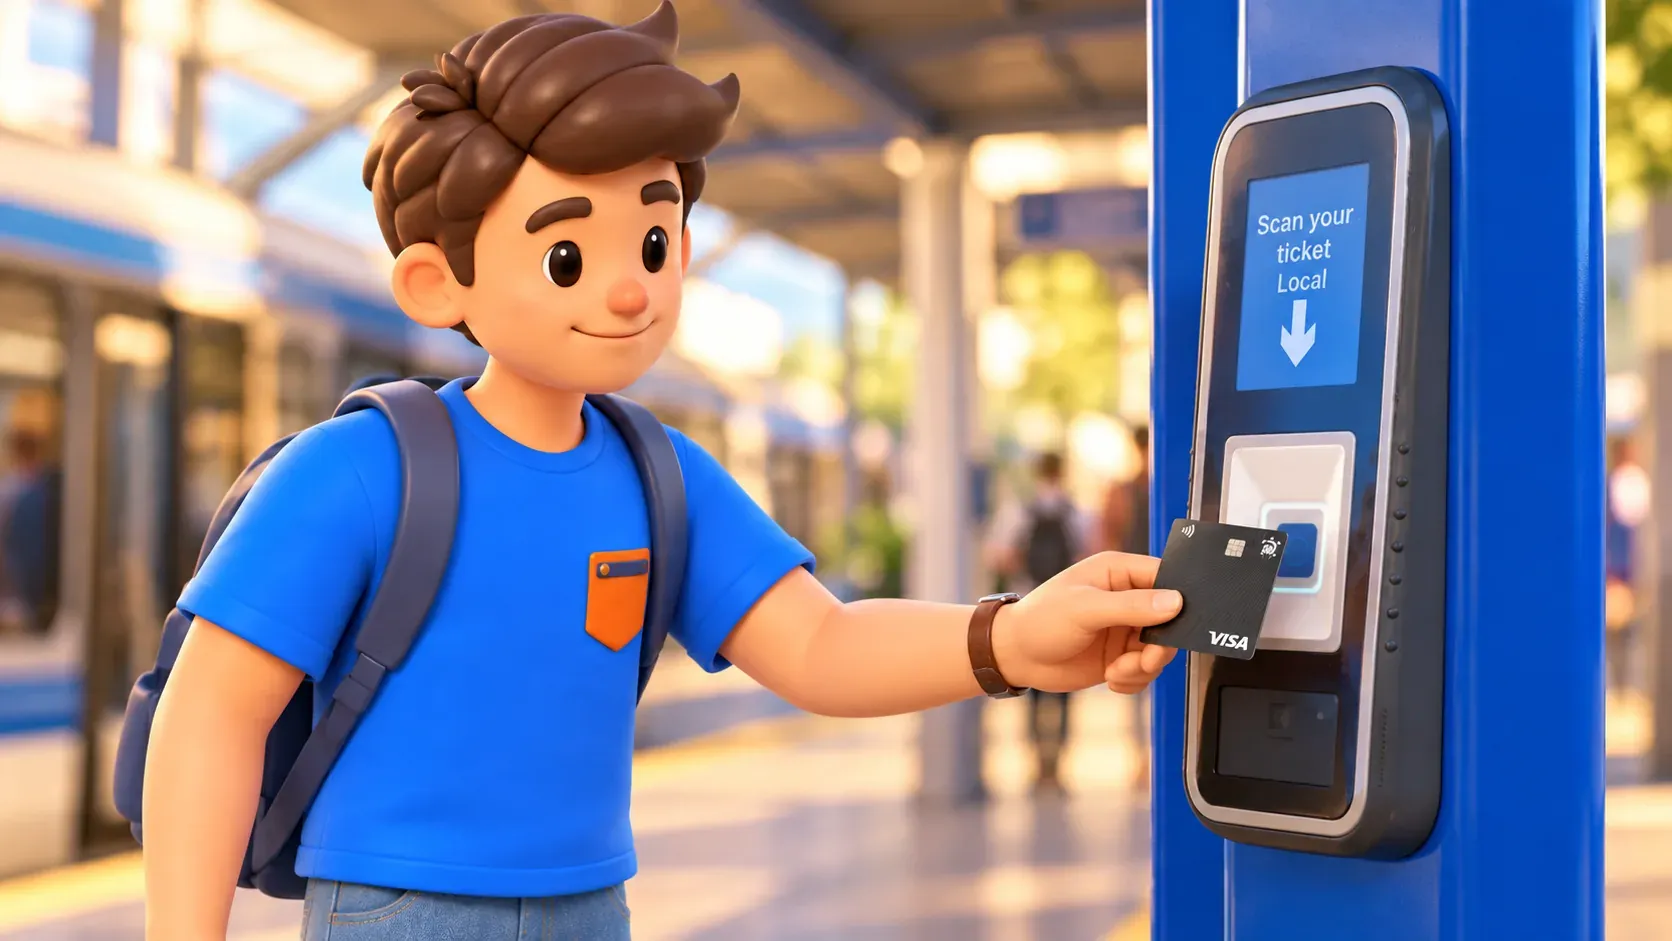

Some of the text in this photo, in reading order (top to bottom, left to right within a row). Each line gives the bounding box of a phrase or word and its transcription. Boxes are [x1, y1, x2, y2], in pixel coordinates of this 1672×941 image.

[1257, 207, 1354, 235] Scan your
[1277, 239, 1331, 264] ticket
[1277, 268, 1327, 293] Local
[1208, 630, 1249, 650] VISA
